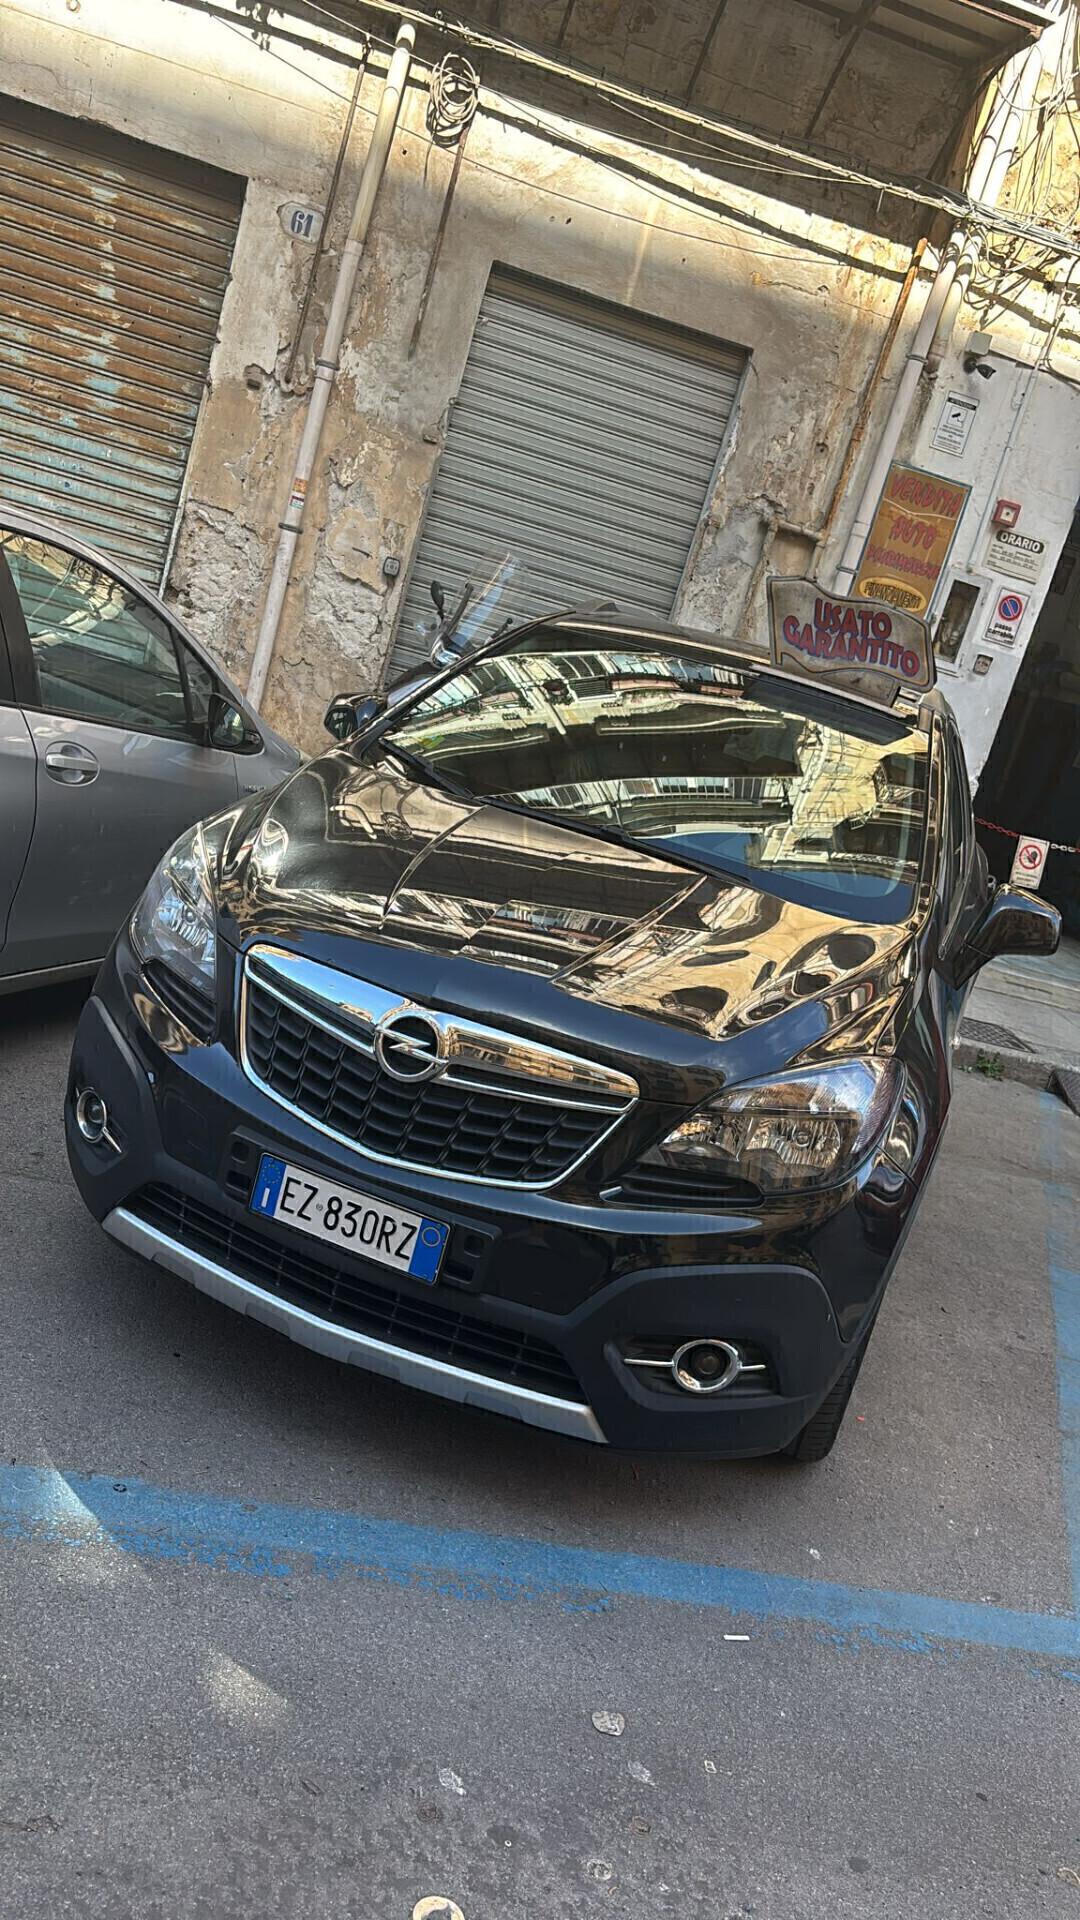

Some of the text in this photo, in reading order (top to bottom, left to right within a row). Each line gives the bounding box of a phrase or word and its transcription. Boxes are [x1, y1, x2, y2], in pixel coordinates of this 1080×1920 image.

[291, 210, 314, 238] 61
[890, 473, 963, 518] VENDITA
[889, 515, 938, 550] AUTO
[1000, 532, 1041, 552] ORARIO
[814, 597, 893, 640] USATO
[783, 615, 921, 678] GARANTITO
